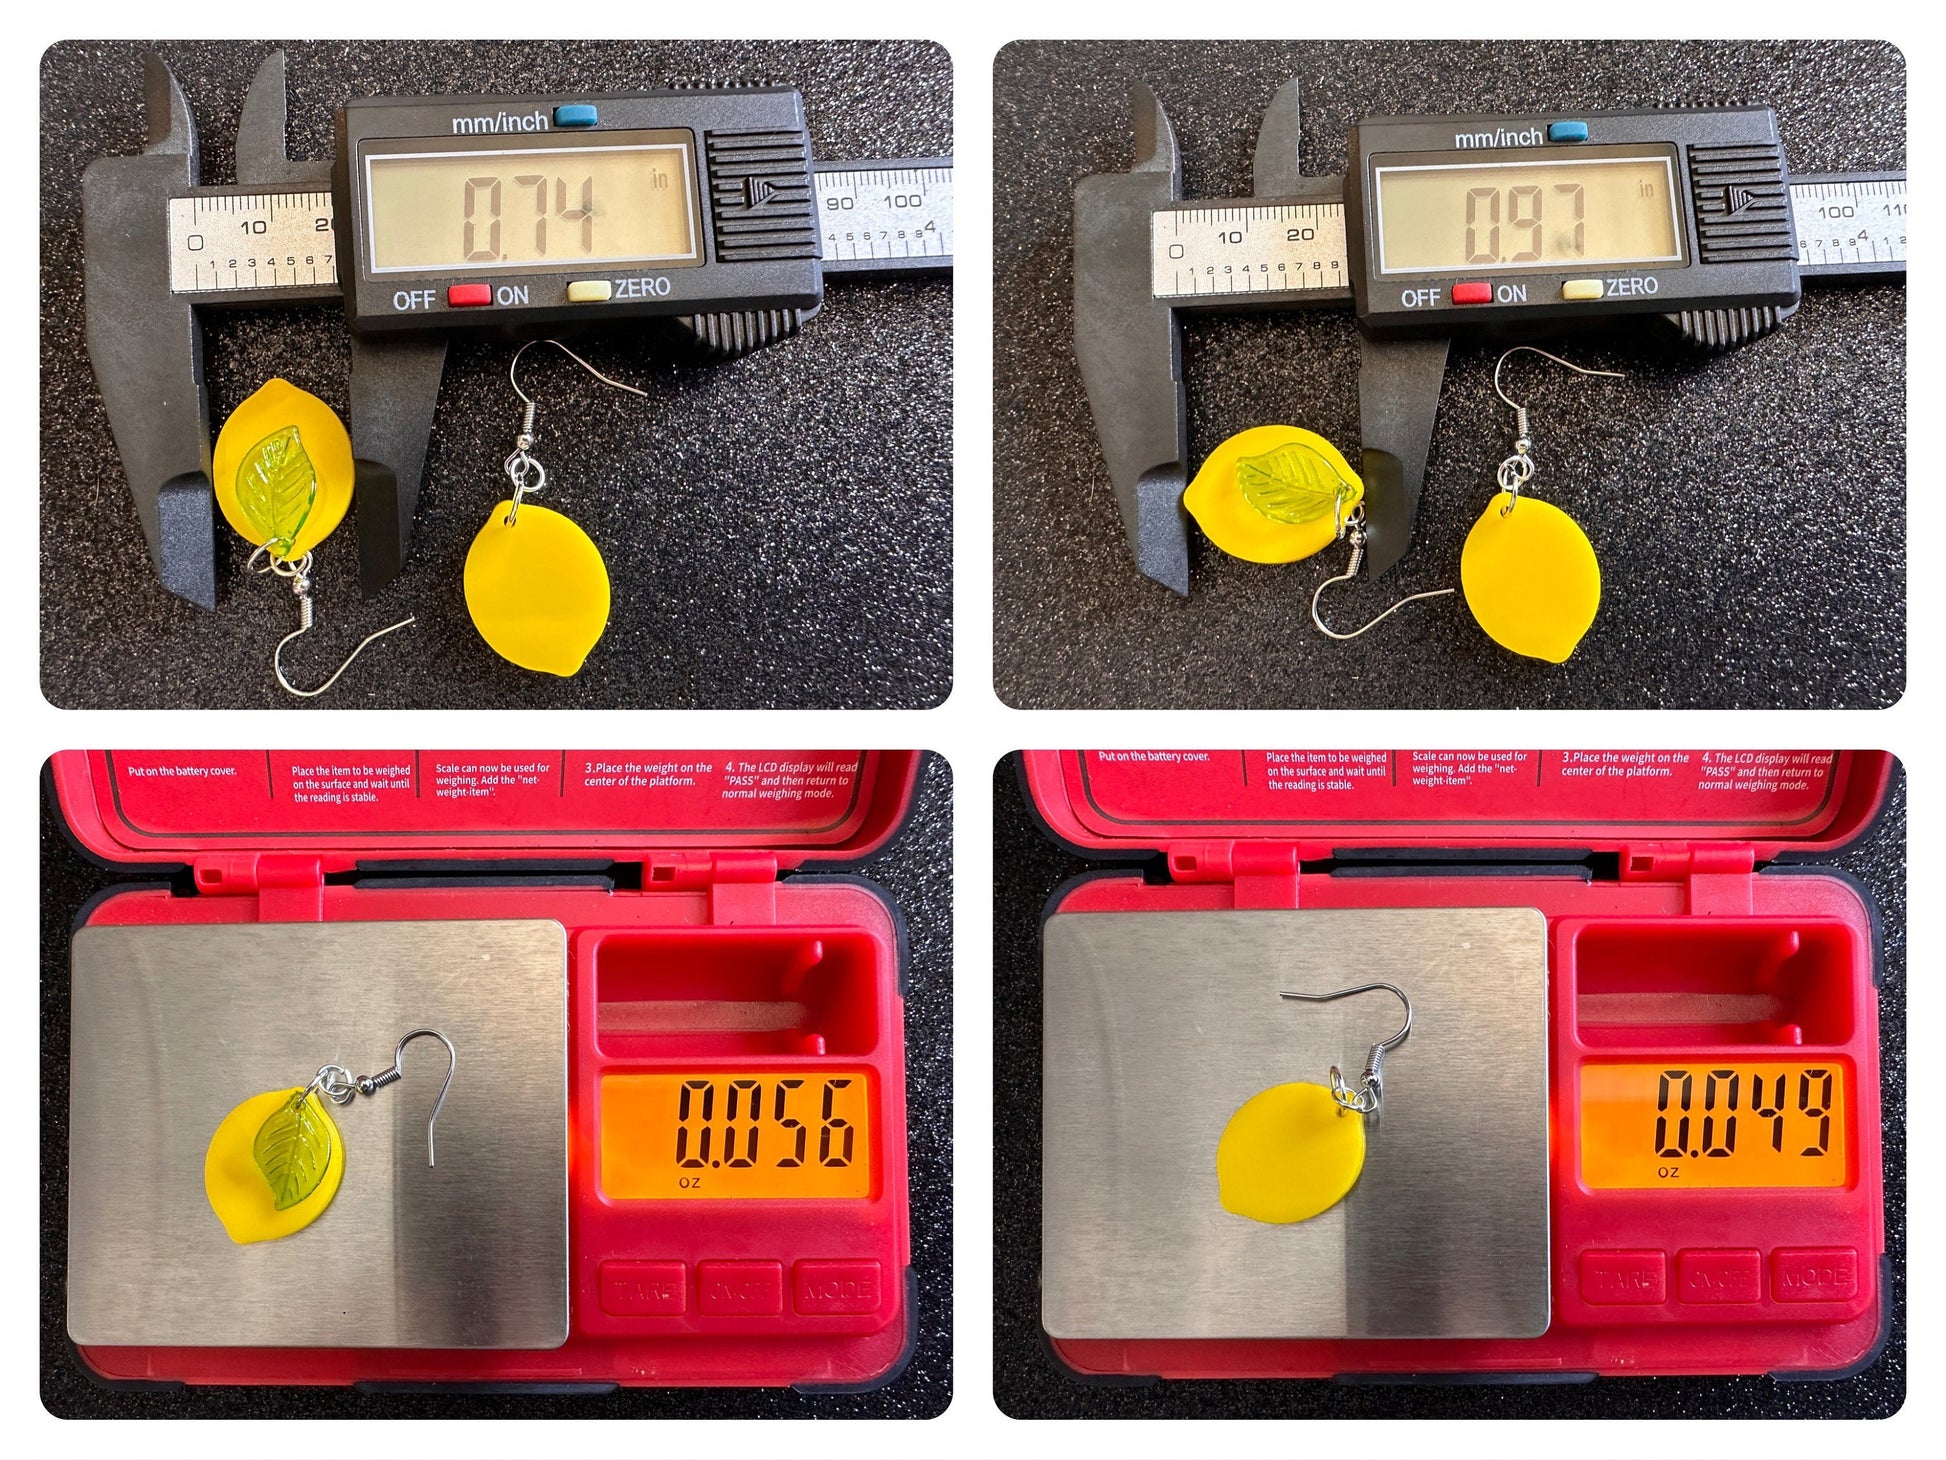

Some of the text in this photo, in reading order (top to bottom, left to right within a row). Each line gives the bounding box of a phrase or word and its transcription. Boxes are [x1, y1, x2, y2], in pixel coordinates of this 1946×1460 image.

[452, 111, 549, 134] mm/inch
[1455, 127, 1543, 148] mm/inch
[650, 168, 668, 190] in
[1639, 179, 1655, 198] in
[826, 195, 922, 210] 90 100
[463, 175, 593, 261] 0.74
[1818, 206, 1854, 219] 100
[240, 221, 267, 235] 10
[1465, 183, 1585, 264] 0.97
[1218, 228, 1315, 244] 10 20
[615, 277, 671, 299] ZERO
[1497, 284, 1527, 303] ON
[1606, 276, 1659, 297] ZERO
[393, 290, 436, 311] OFF
[497, 285, 529, 305] ON
[1401, 288, 1441, 308] OFF
[1098, 751, 1210, 764] Put on the battery cover.
[1266, 751, 1387, 766] Place the item to be weighed
[1412, 751, 1528, 761] Scale can now be used for
[1562, 751, 1690, 765] 3.Place the weight on the
[1702, 752, 1834, 766] 4. The LCD display will read
[128, 766, 237, 778] Put on the battery cover.
[292, 764, 411, 778] Place the item to be weighed
[436, 762, 550, 773] Scale can now be used for
[585, 762, 713, 775] 3.Place the weight on the
[725, 761, 859, 774] 4. The LCD display will read
[1267, 765, 1386, 776] on the surface and wait until
[1412, 763, 1517, 775] weighing. Add the "net-
[1561, 765, 1672, 778] center of the platform.
[1701, 766, 1824, 778] "PASS" and then return to
[293, 778, 410, 790] on the surface and wait until
[436, 775, 540, 787] weighing. Add the "net-
[584, 775, 696, 788] center of the platform.
[724, 775, 849, 786] "PASS" and then return to
[1268, 779, 1354, 792] the reading is stable.
[1412, 775, 1472, 788] weight-item".
[1698, 779, 1809, 792] normal weighing mode.
[294, 791, 379, 805] the reading is stable.
[436, 787, 496, 799] weight-item".
[722, 788, 834, 801] normal weighing mode.
[1655, 1069, 1832, 1158] 0.049
[676, 1079, 854, 1168] 0.056
[1782, 1268, 1848, 1287] MODE
[805, 1280, 872, 1300] MODE
